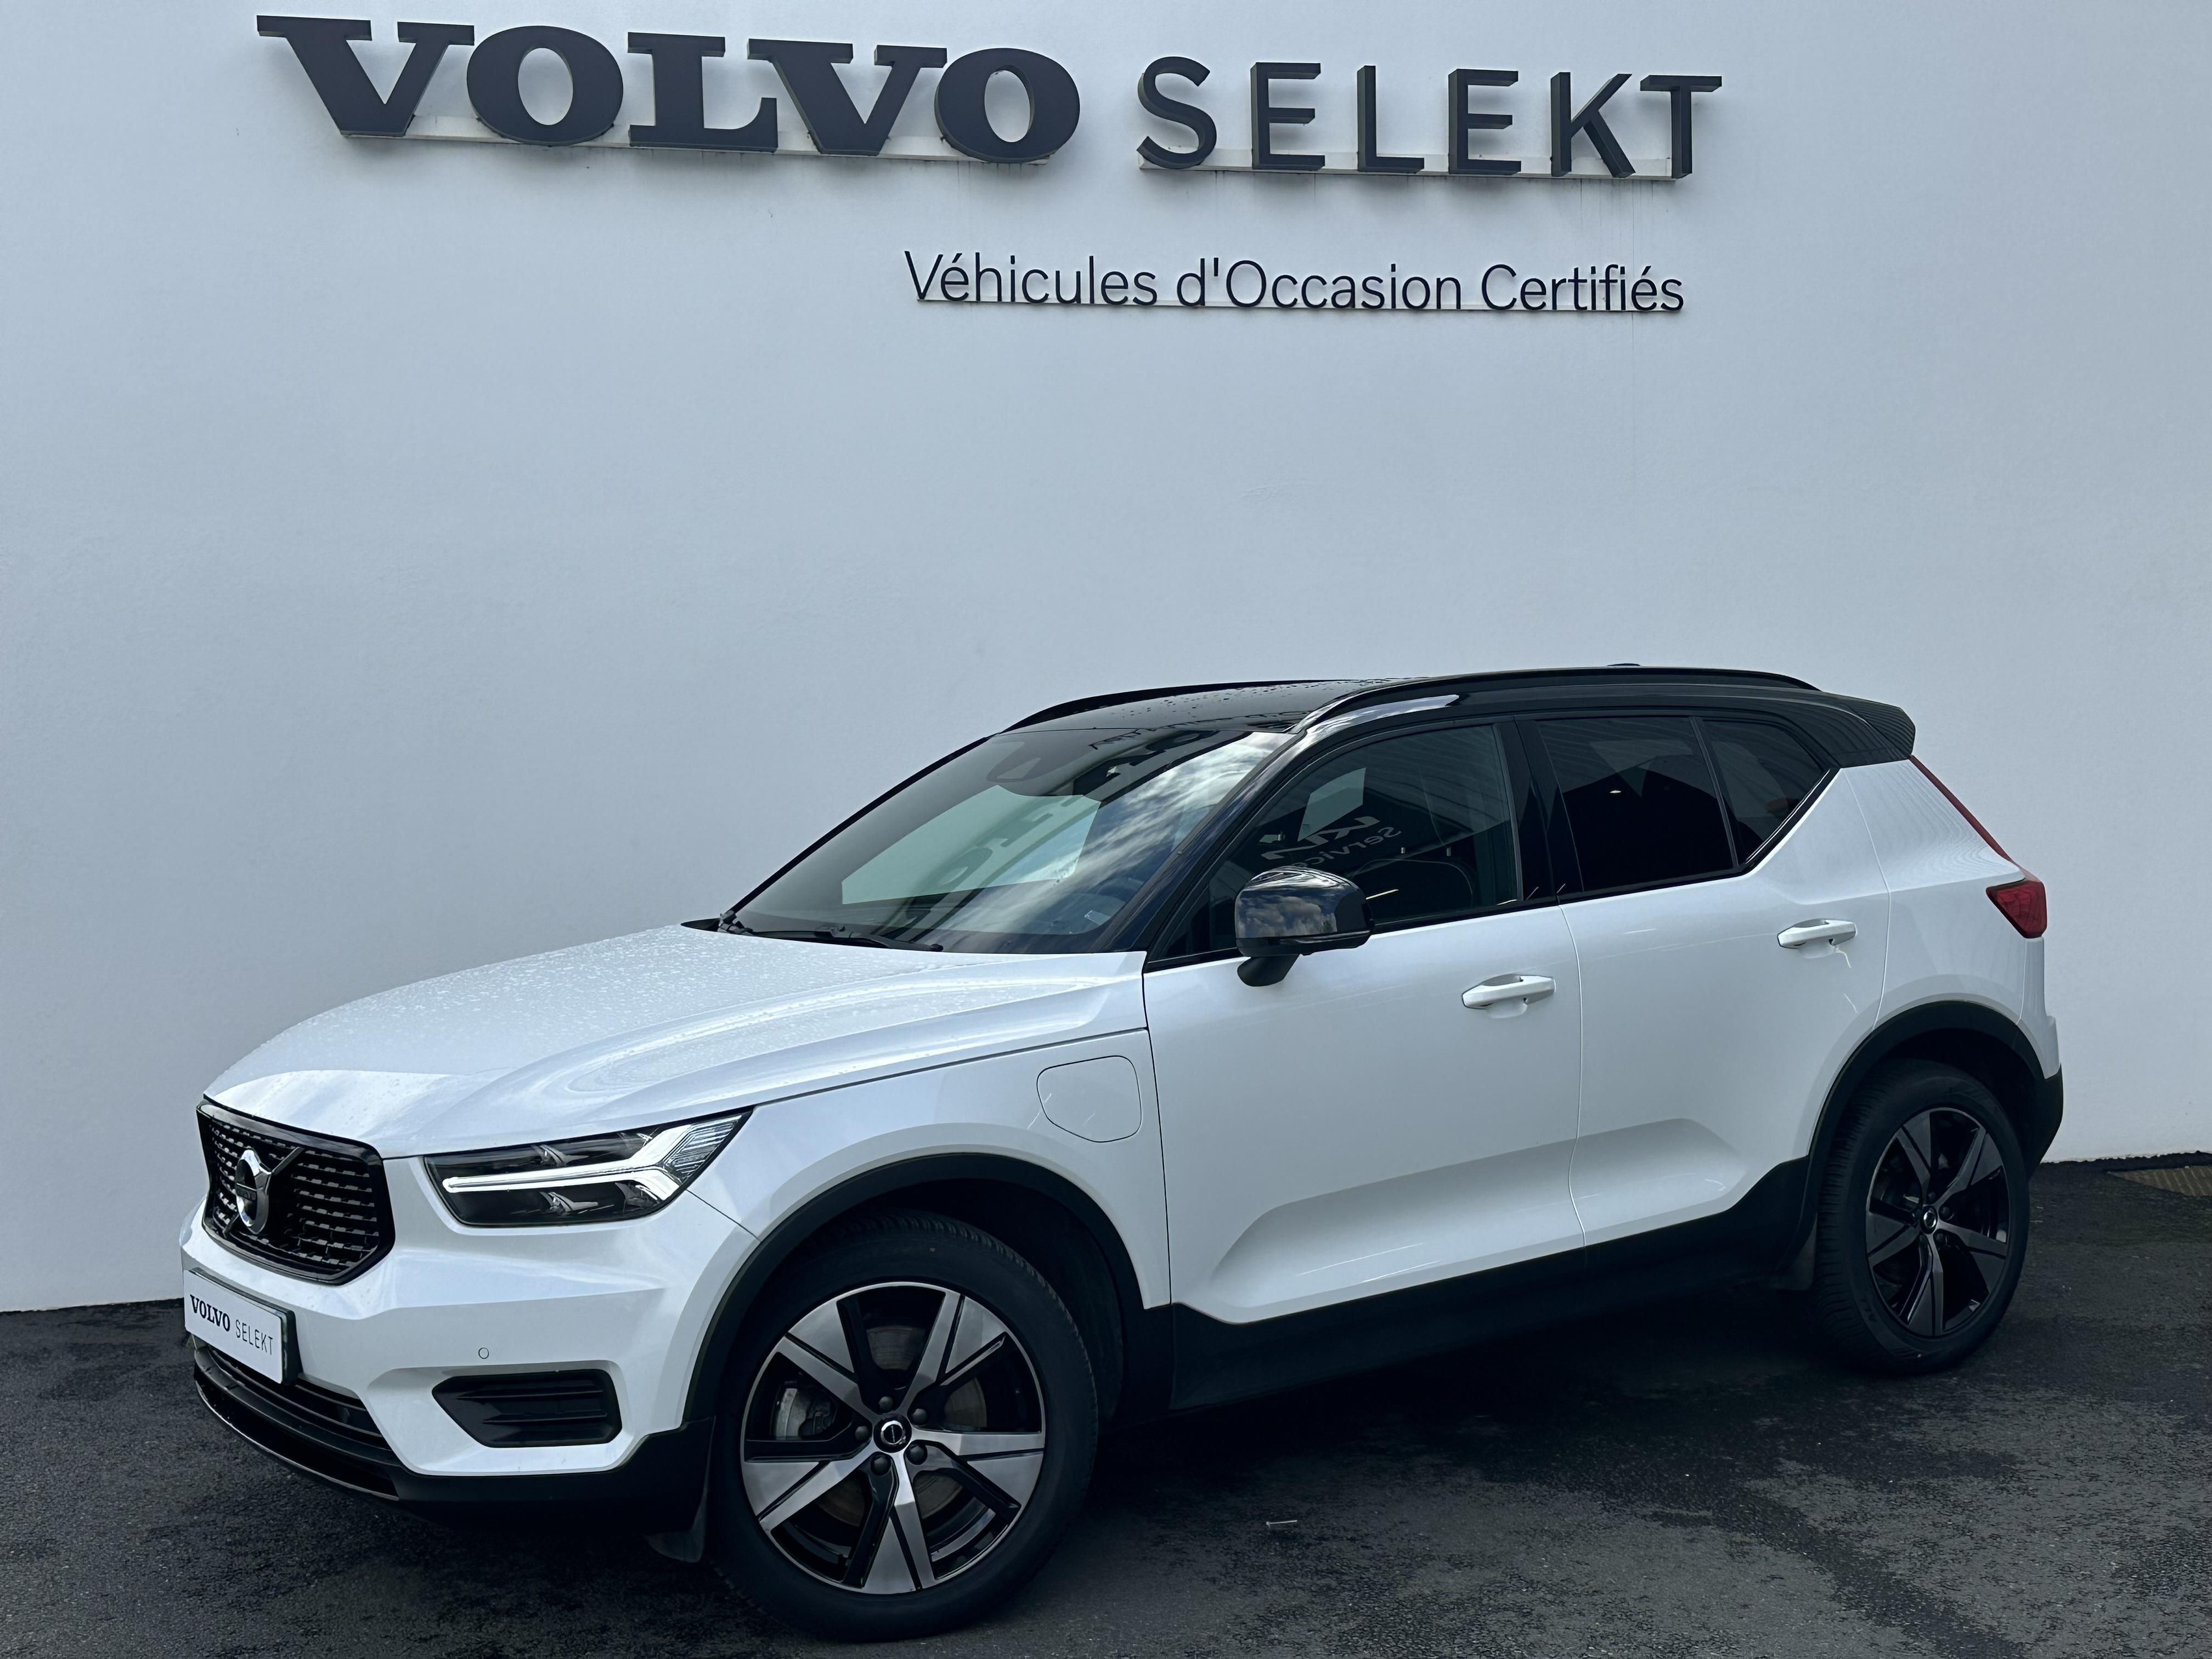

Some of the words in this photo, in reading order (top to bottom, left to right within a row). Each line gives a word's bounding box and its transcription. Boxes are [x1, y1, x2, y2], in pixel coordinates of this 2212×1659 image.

[257, 15, 1080, 163] VOLVO
[1137, 56, 1722, 179] SELEKT
[904, 251, 1158, 306] Véhicules
[1177, 257, 1461, 309] d'Occasion
[1481, 264, 1684, 311] Certifiés
[190, 1294, 230, 1331] VOLVO
[235, 1319, 273, 1355] SELEKT
